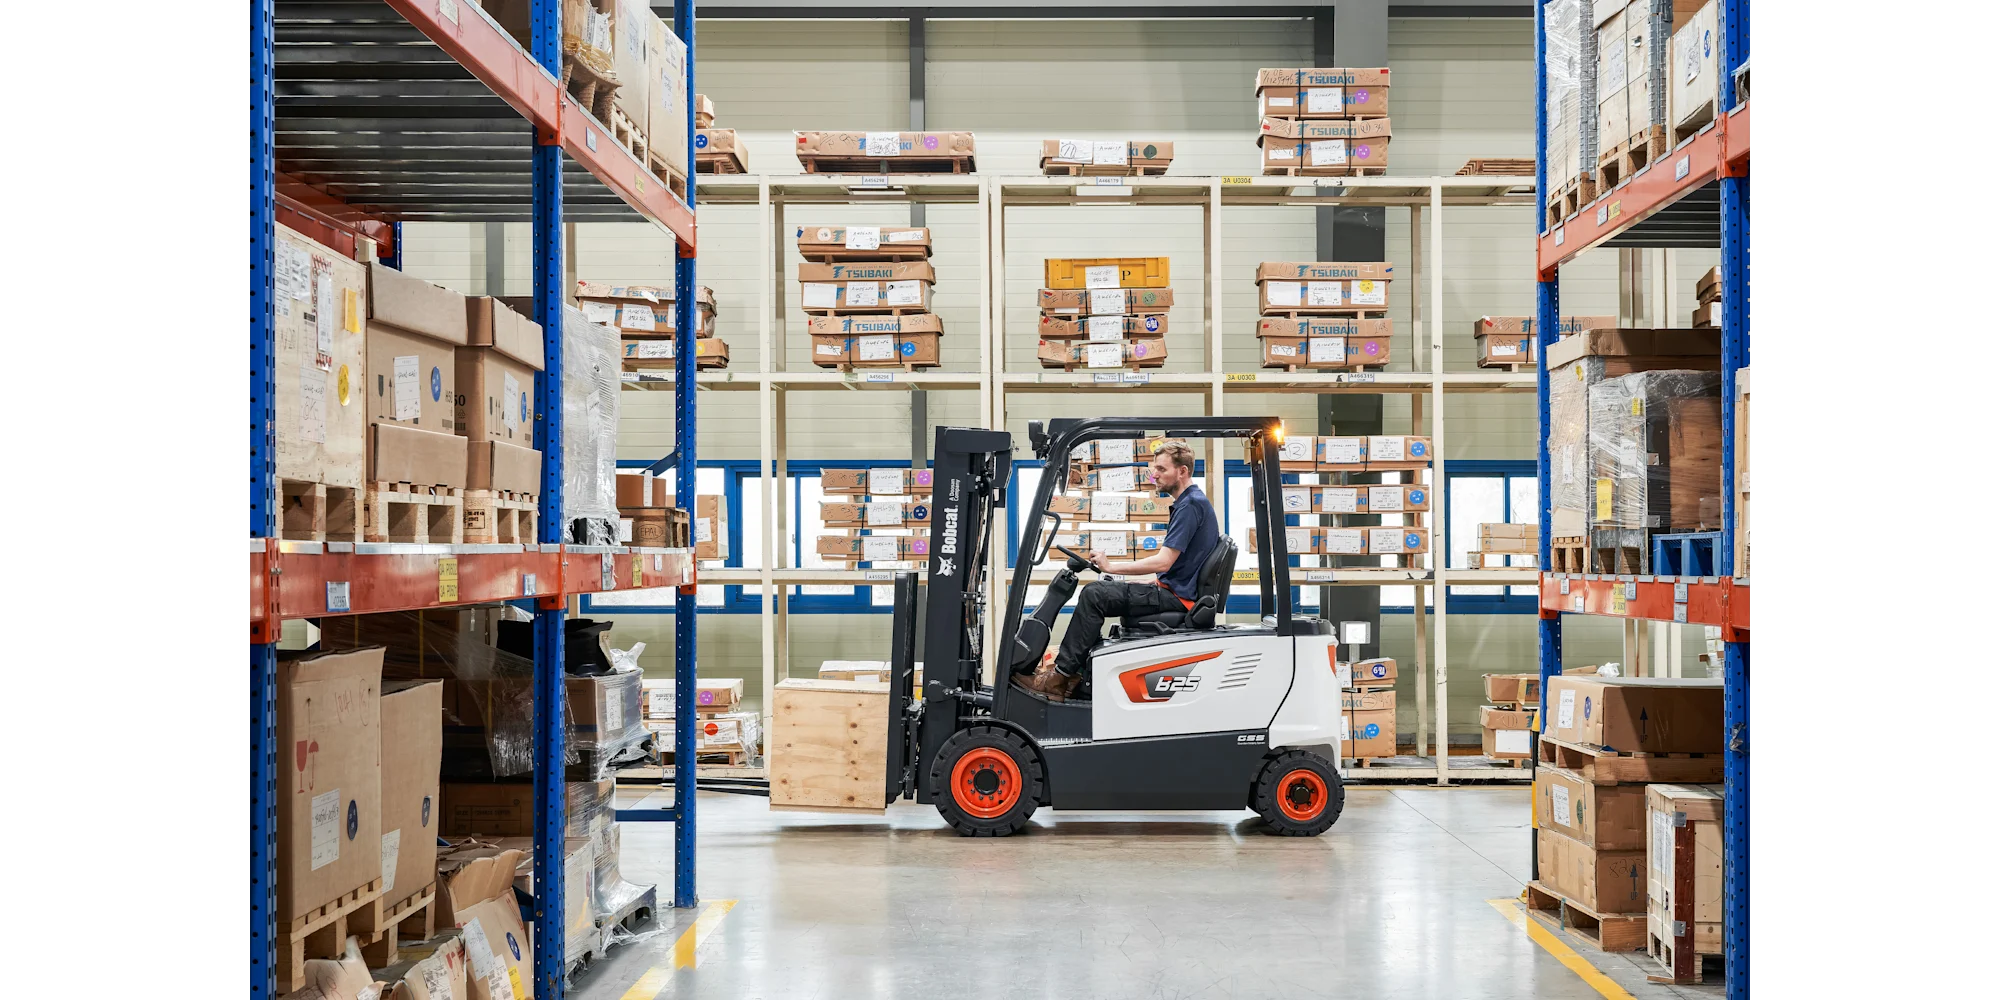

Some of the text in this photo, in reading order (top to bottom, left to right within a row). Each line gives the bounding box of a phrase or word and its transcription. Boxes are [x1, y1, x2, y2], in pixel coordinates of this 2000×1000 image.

[1308, 75, 1355, 84] TSUBAKI
[1310, 127, 1357, 136] TSUBAKI
[846, 269, 893, 278] TSUBAKI
[1122, 270, 1131, 280] P
[1310, 269, 1358, 278] TSUBAKI
[626, 289, 672, 299] TSUAKI
[855, 323, 901, 332] TSUBAKI
[1311, 326, 1358, 335] TSUBAKI
[640, 527, 658, 536] EPAL
[1630, 891, 1638, 901] UP
